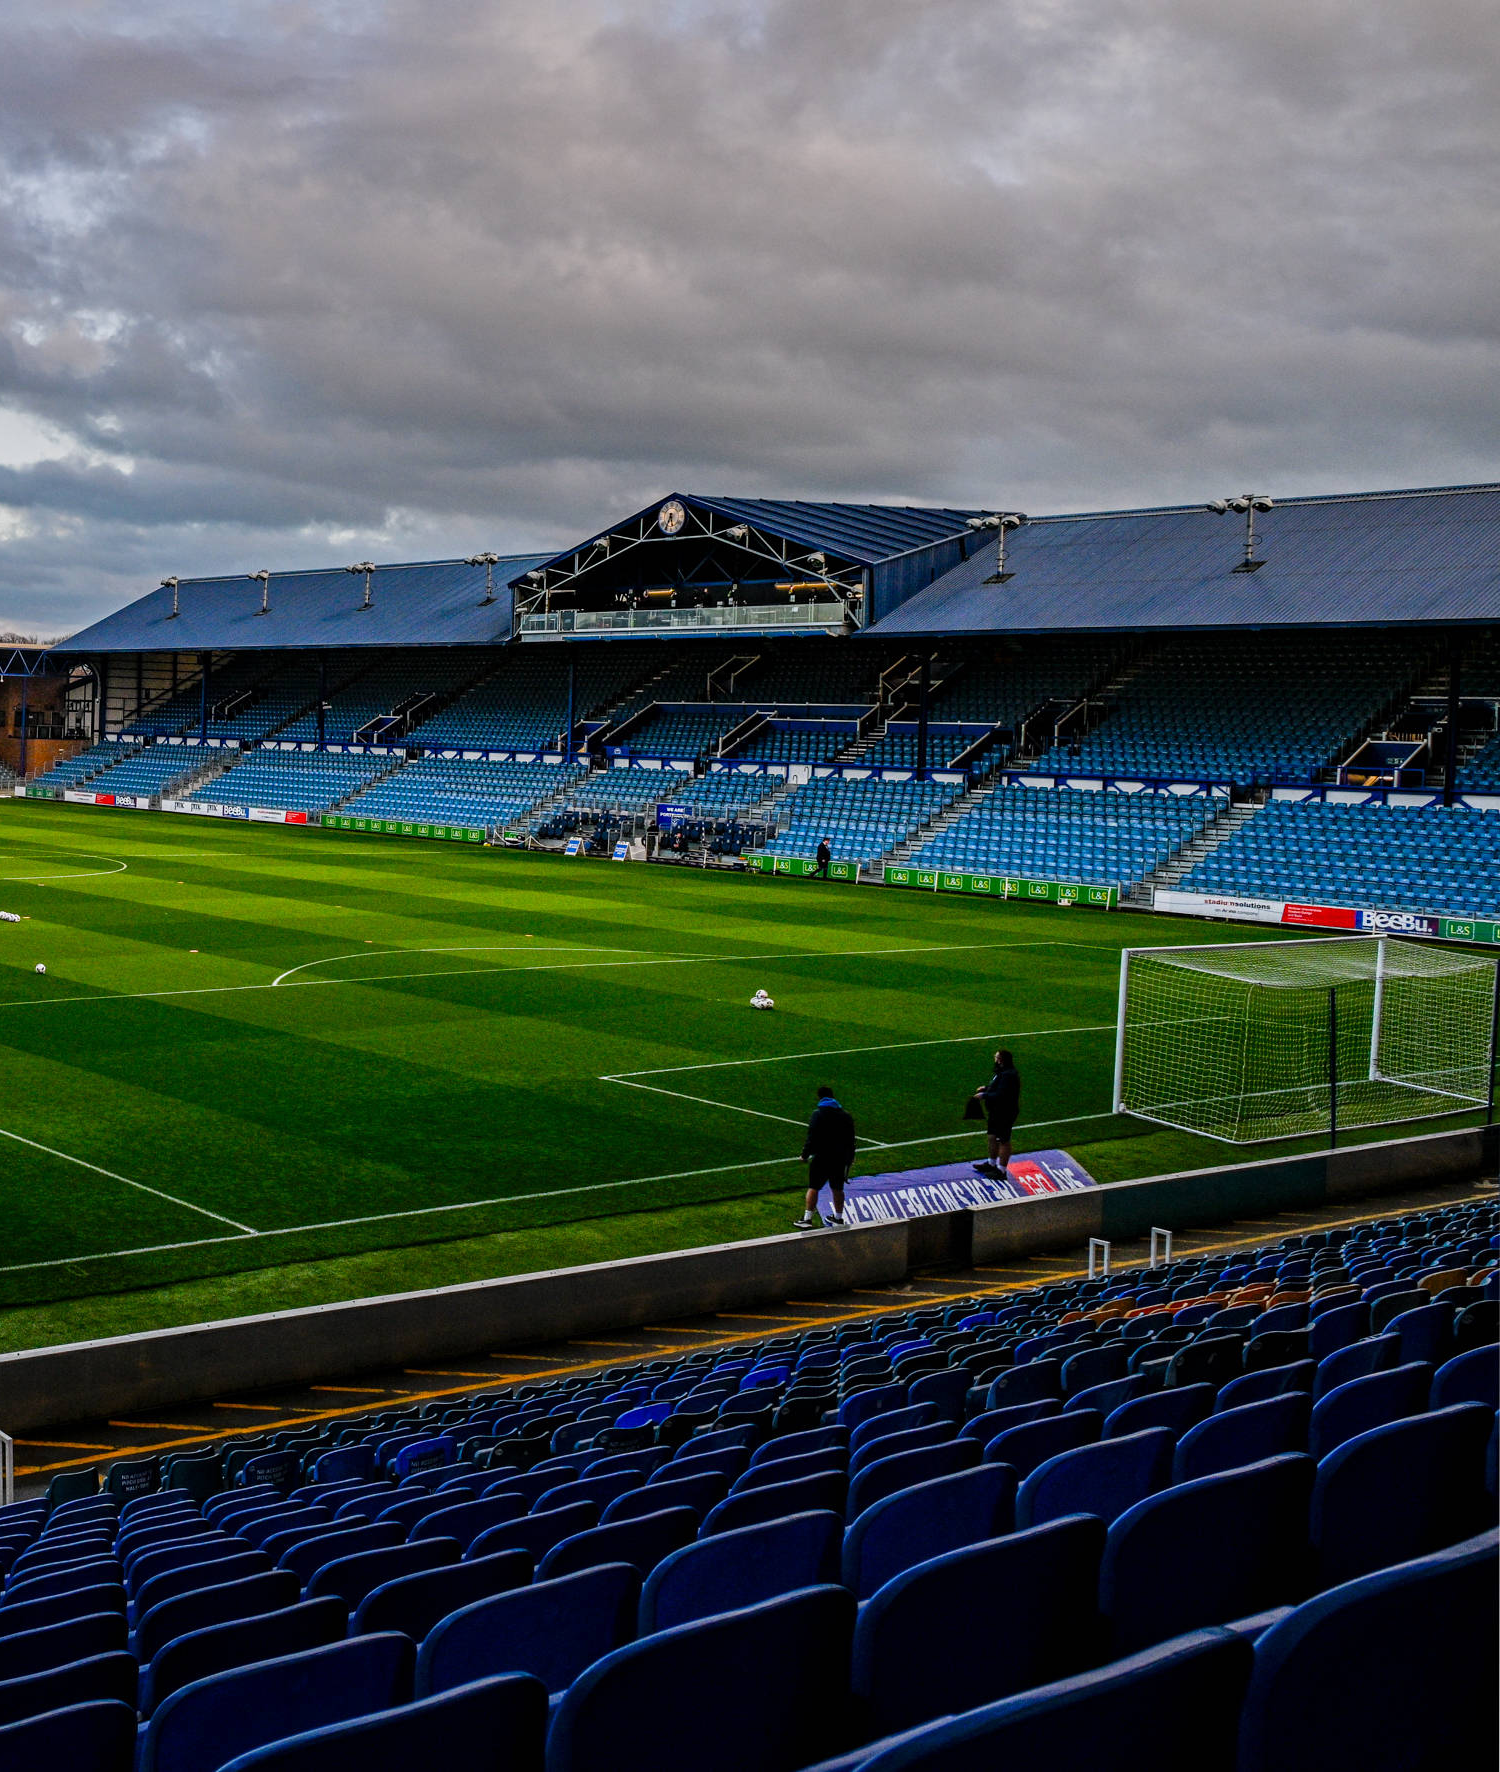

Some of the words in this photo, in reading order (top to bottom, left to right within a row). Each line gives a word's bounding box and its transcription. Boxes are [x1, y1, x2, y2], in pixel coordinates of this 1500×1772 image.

[750, 859, 761, 867] L&S
[833, 865, 846, 875] L&S
[893, 872, 907, 881] L&S
[919, 874, 933, 883] L&S
[946, 877, 960, 886] L&S
[973, 880, 988, 889] L&S
[1001, 883, 1017, 891] L&S
[1030, 886, 1046, 895] L&S
[1060, 889, 1076, 898] L&S
[1091, 892, 1107, 901] L&S
[1362, 911, 1432, 932] BeeBu.
[1451, 925, 1470, 936] L&S
